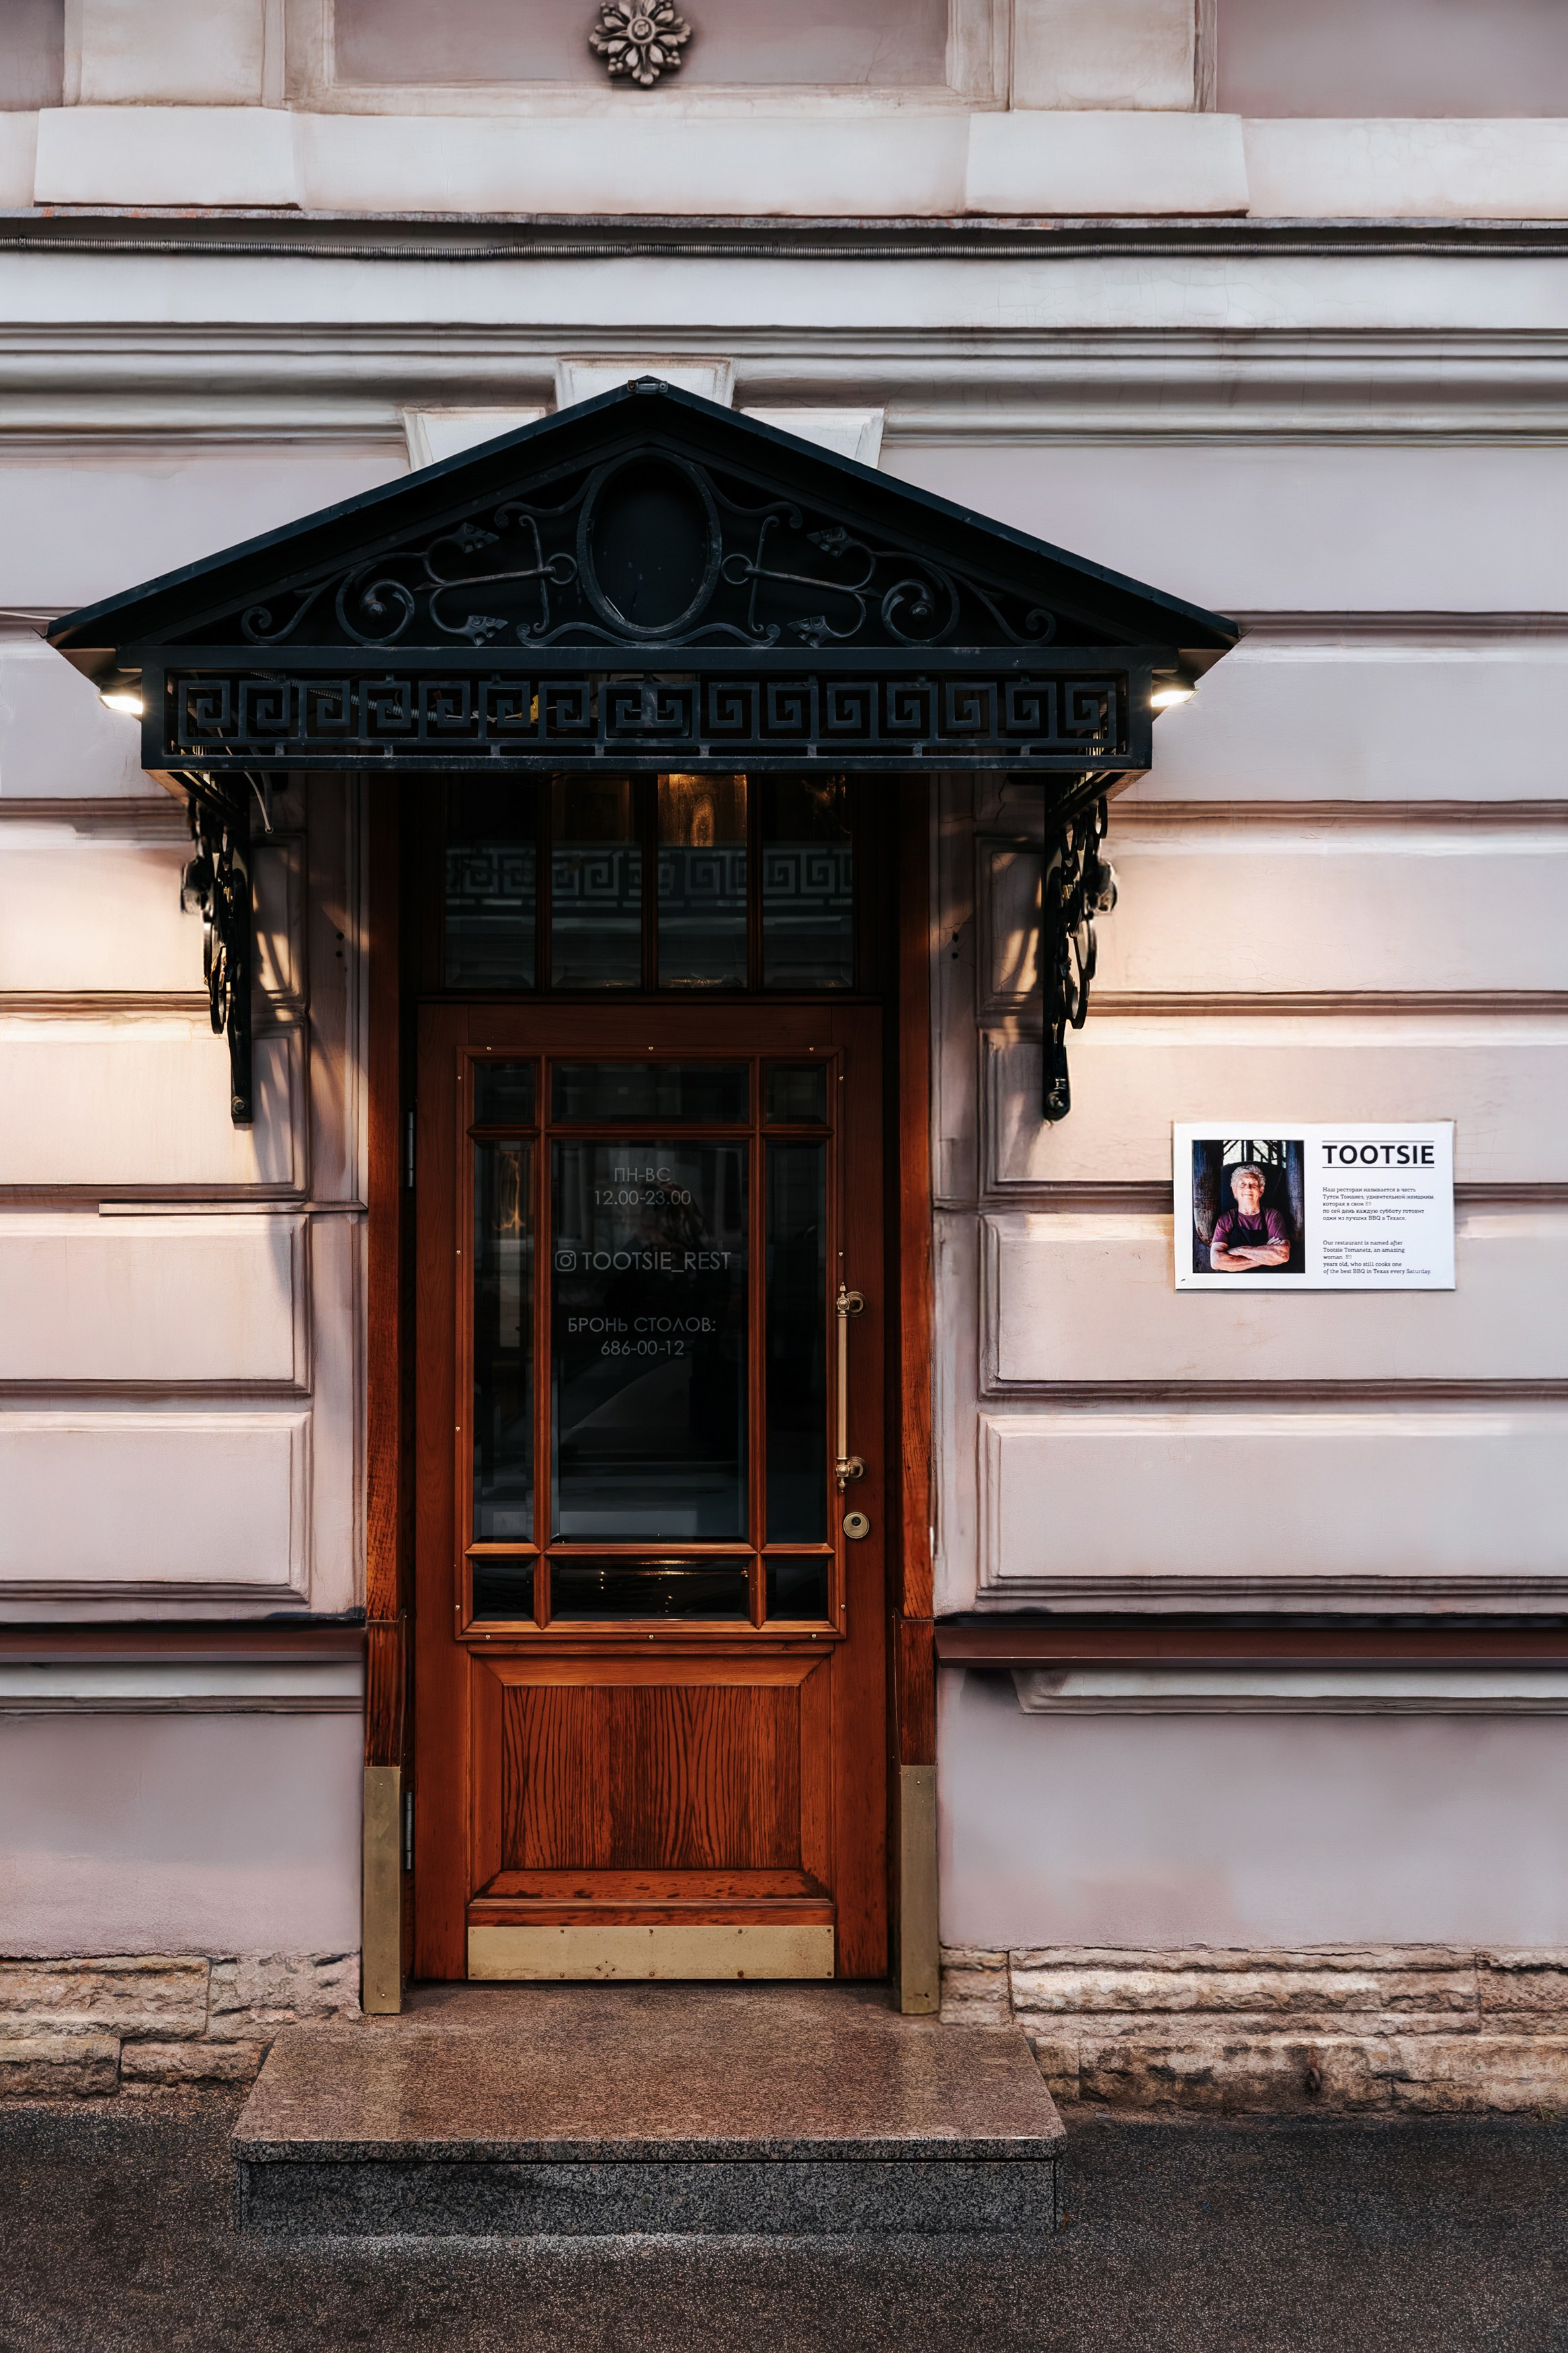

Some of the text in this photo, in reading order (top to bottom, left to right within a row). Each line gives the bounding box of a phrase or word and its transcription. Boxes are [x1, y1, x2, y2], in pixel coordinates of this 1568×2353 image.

[1322, 1145, 1434, 1164] TOOTSIE
[614, 1167, 671, 1182] ПН-ВС
[594, 1190, 691, 1205] 12.00-23.00
[581, 1251, 731, 1272] TOOTSIE_REST
[568, 1318, 628, 1332] БРОНЬ
[601, 1341, 684, 1355] 686-00-12
